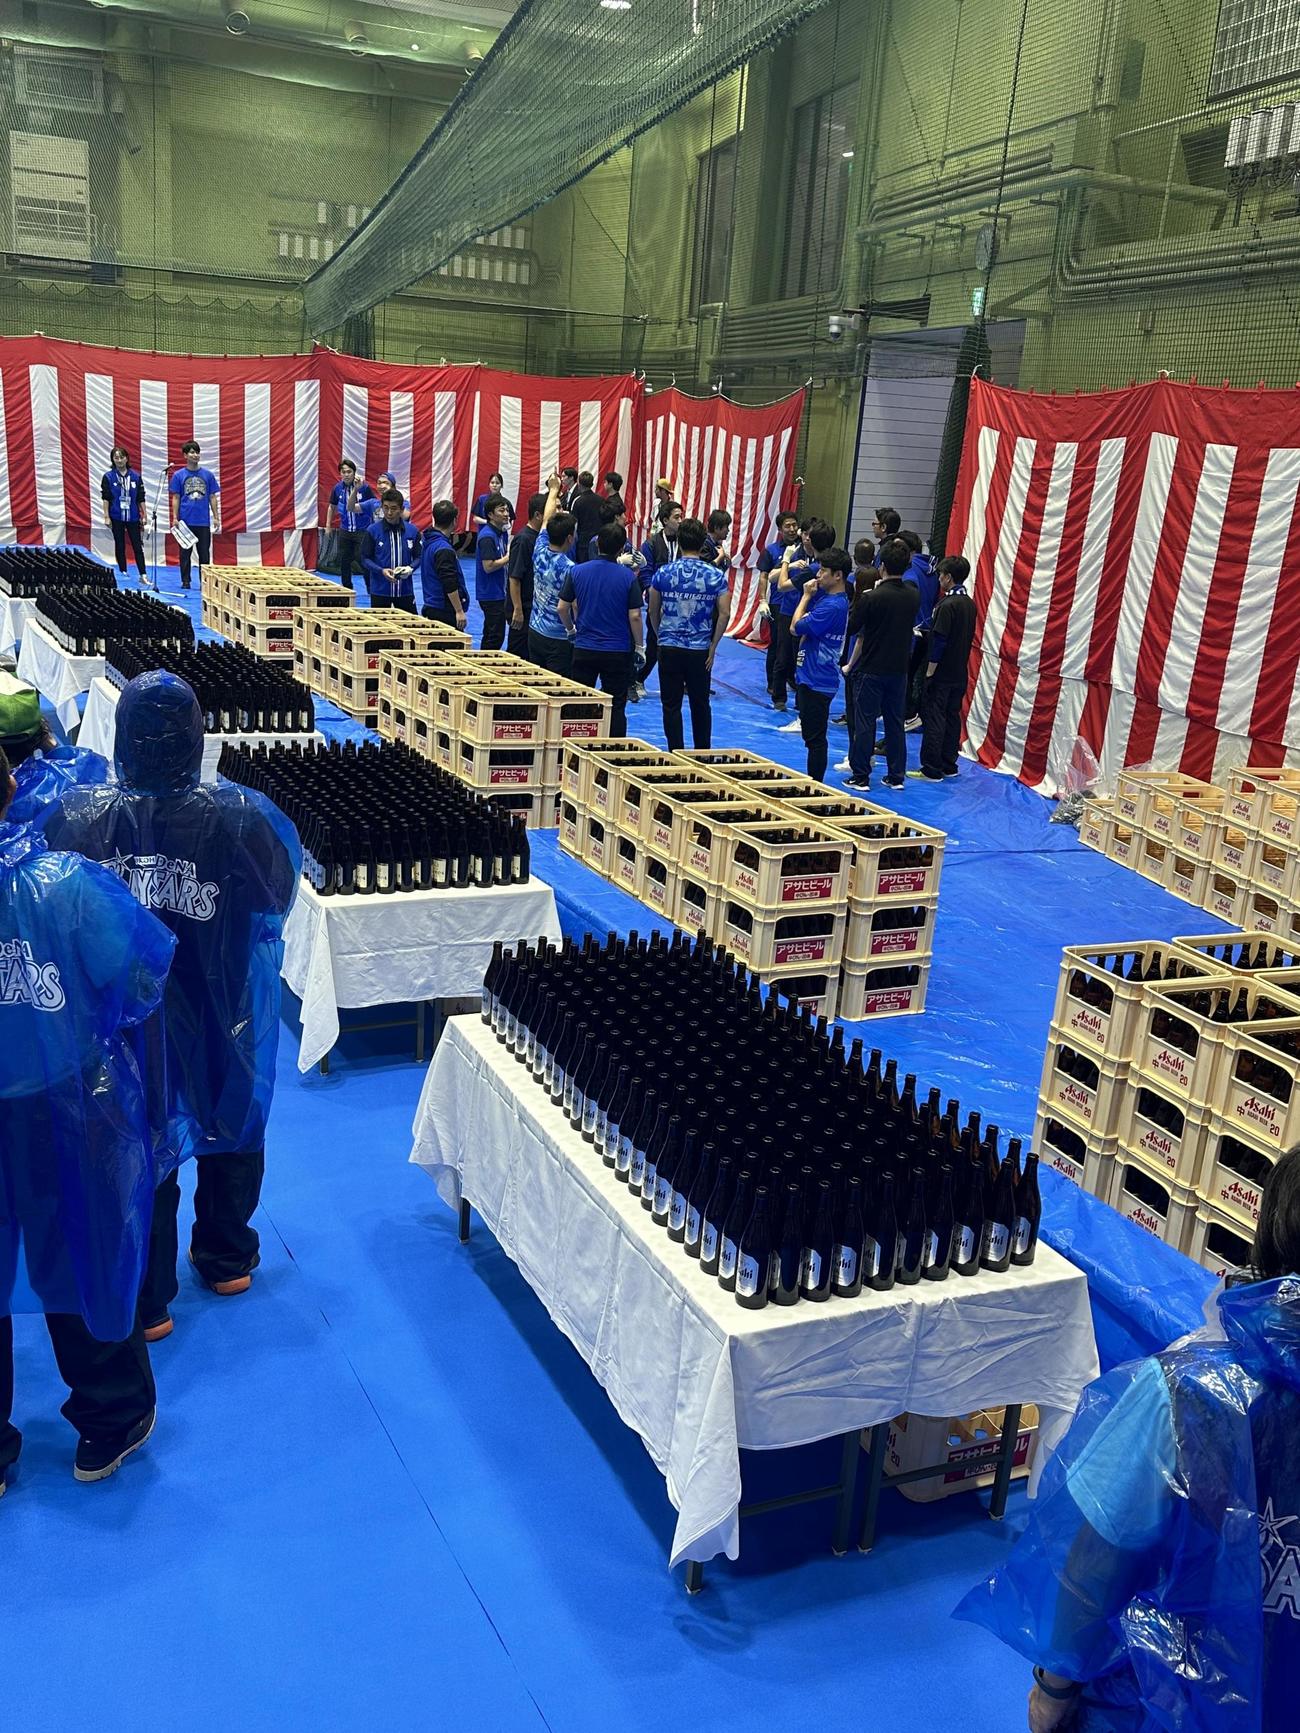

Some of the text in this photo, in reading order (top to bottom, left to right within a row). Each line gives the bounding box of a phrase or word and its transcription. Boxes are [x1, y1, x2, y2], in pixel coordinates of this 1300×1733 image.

[495, 724, 533, 733] アサヒビール
[562, 723, 599, 732] アサヒビール
[491, 769, 528, 778] アサヒビール
[156, 853, 197, 879] DeNA
[738, 872, 754, 886] Asahi
[784, 879, 832, 892] アサヒビール
[880, 871, 925, 886] アサヒビール
[873, 932, 918, 946] アサヒビール
[777, 941, 825, 955] アサヒビール
[867, 990, 912, 1005] アサヒビール
[1077, 1010, 1102, 1030] Asahi
[1096, 1032, 1105, 1043] 20
[1158, 1050, 1185, 1072] Asahi
[1179, 1074, 1188, 1086] 20
[1065, 1084, 1088, 1105] Asahi
[1083, 1107, 1092, 1118] 20
[1244, 1096, 1276, 1121] Asahi
[1269, 1123, 1280, 1137] 20
[1145, 1130, 1172, 1154] Asahi
[1053, 1157, 1077, 1179] Asahi
[1166, 1156, 1176, 1168] 20
[1228, 1181, 1259, 1206] Asahi
[1132, 1207, 1158, 1232] Asahi
